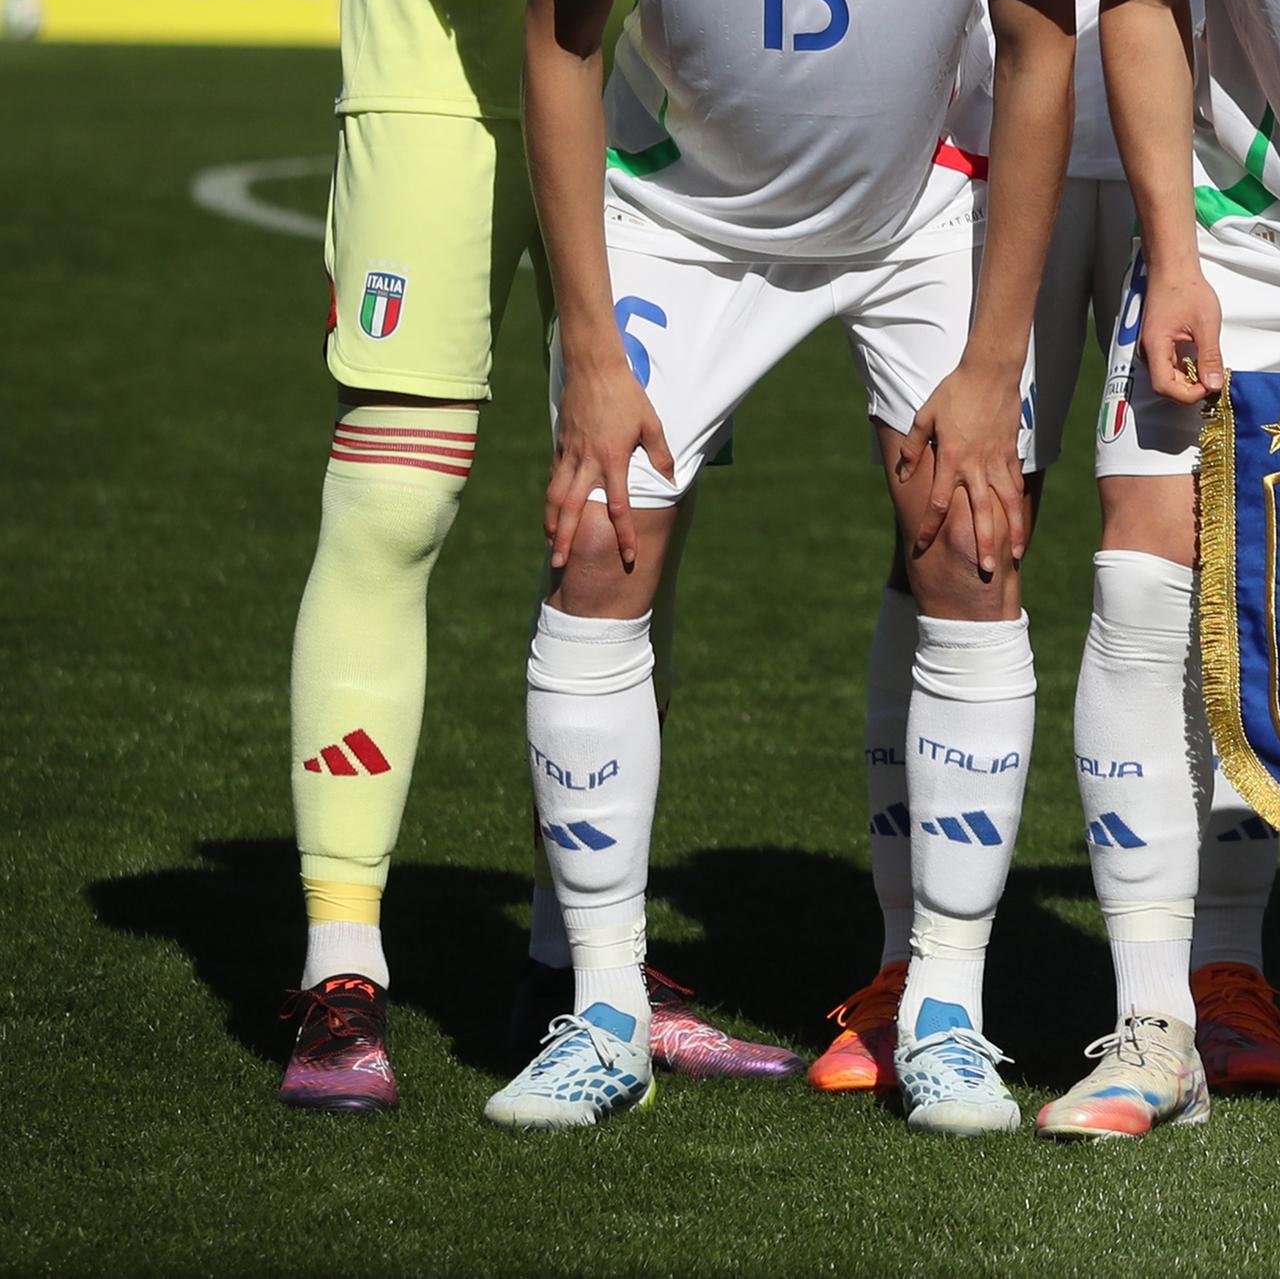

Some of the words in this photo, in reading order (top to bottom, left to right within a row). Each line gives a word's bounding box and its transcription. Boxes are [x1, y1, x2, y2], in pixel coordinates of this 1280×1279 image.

[367, 274, 403, 294] ITALIA
[528, 740, 620, 791] TALIA
[918, 736, 1020, 774] ITALIA
